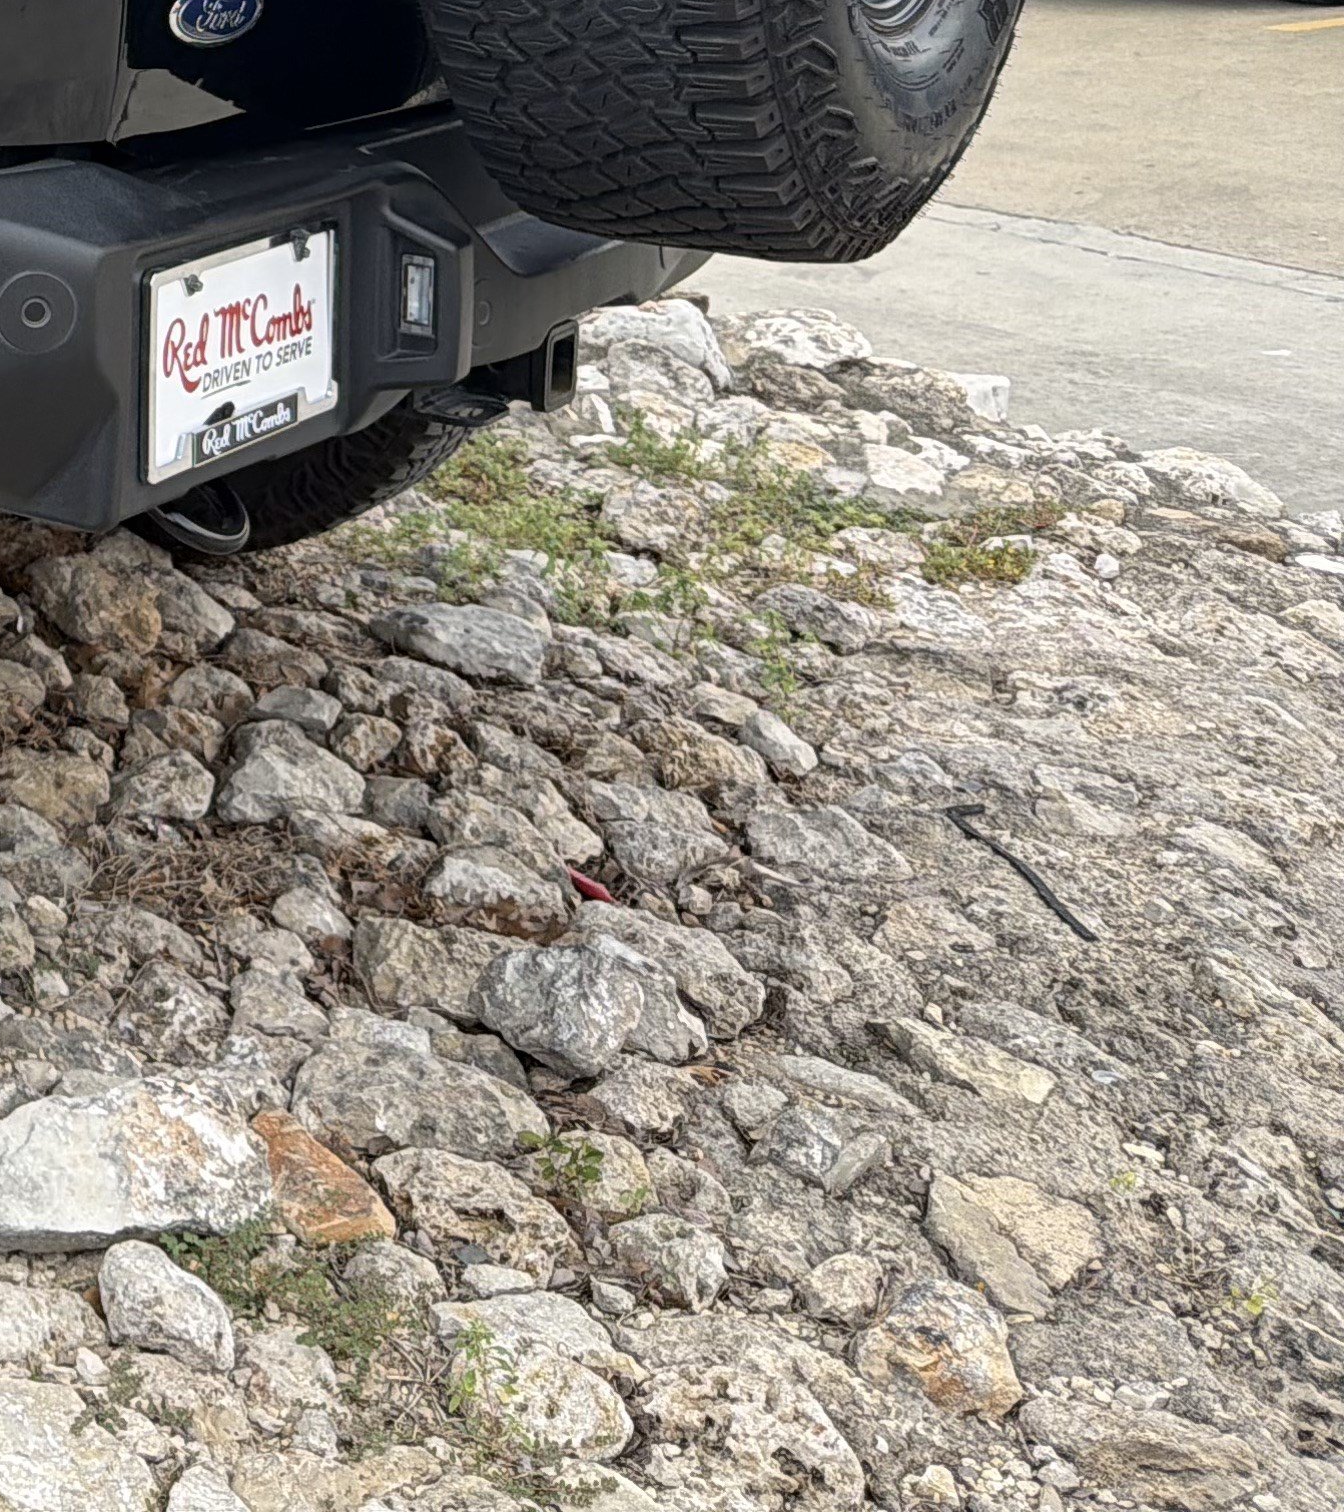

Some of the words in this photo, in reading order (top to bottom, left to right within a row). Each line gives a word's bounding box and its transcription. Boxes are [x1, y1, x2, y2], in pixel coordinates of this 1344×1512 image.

[163, 313, 210, 393] Red
[214, 283, 312, 359] McCombs
[202, 358, 252, 393] DRIVEN
[255, 350, 273, 374] TO
[275, 336, 313, 367] SERVE
[202, 424, 231, 455] Red
[232, 402, 291, 439] McCombs
